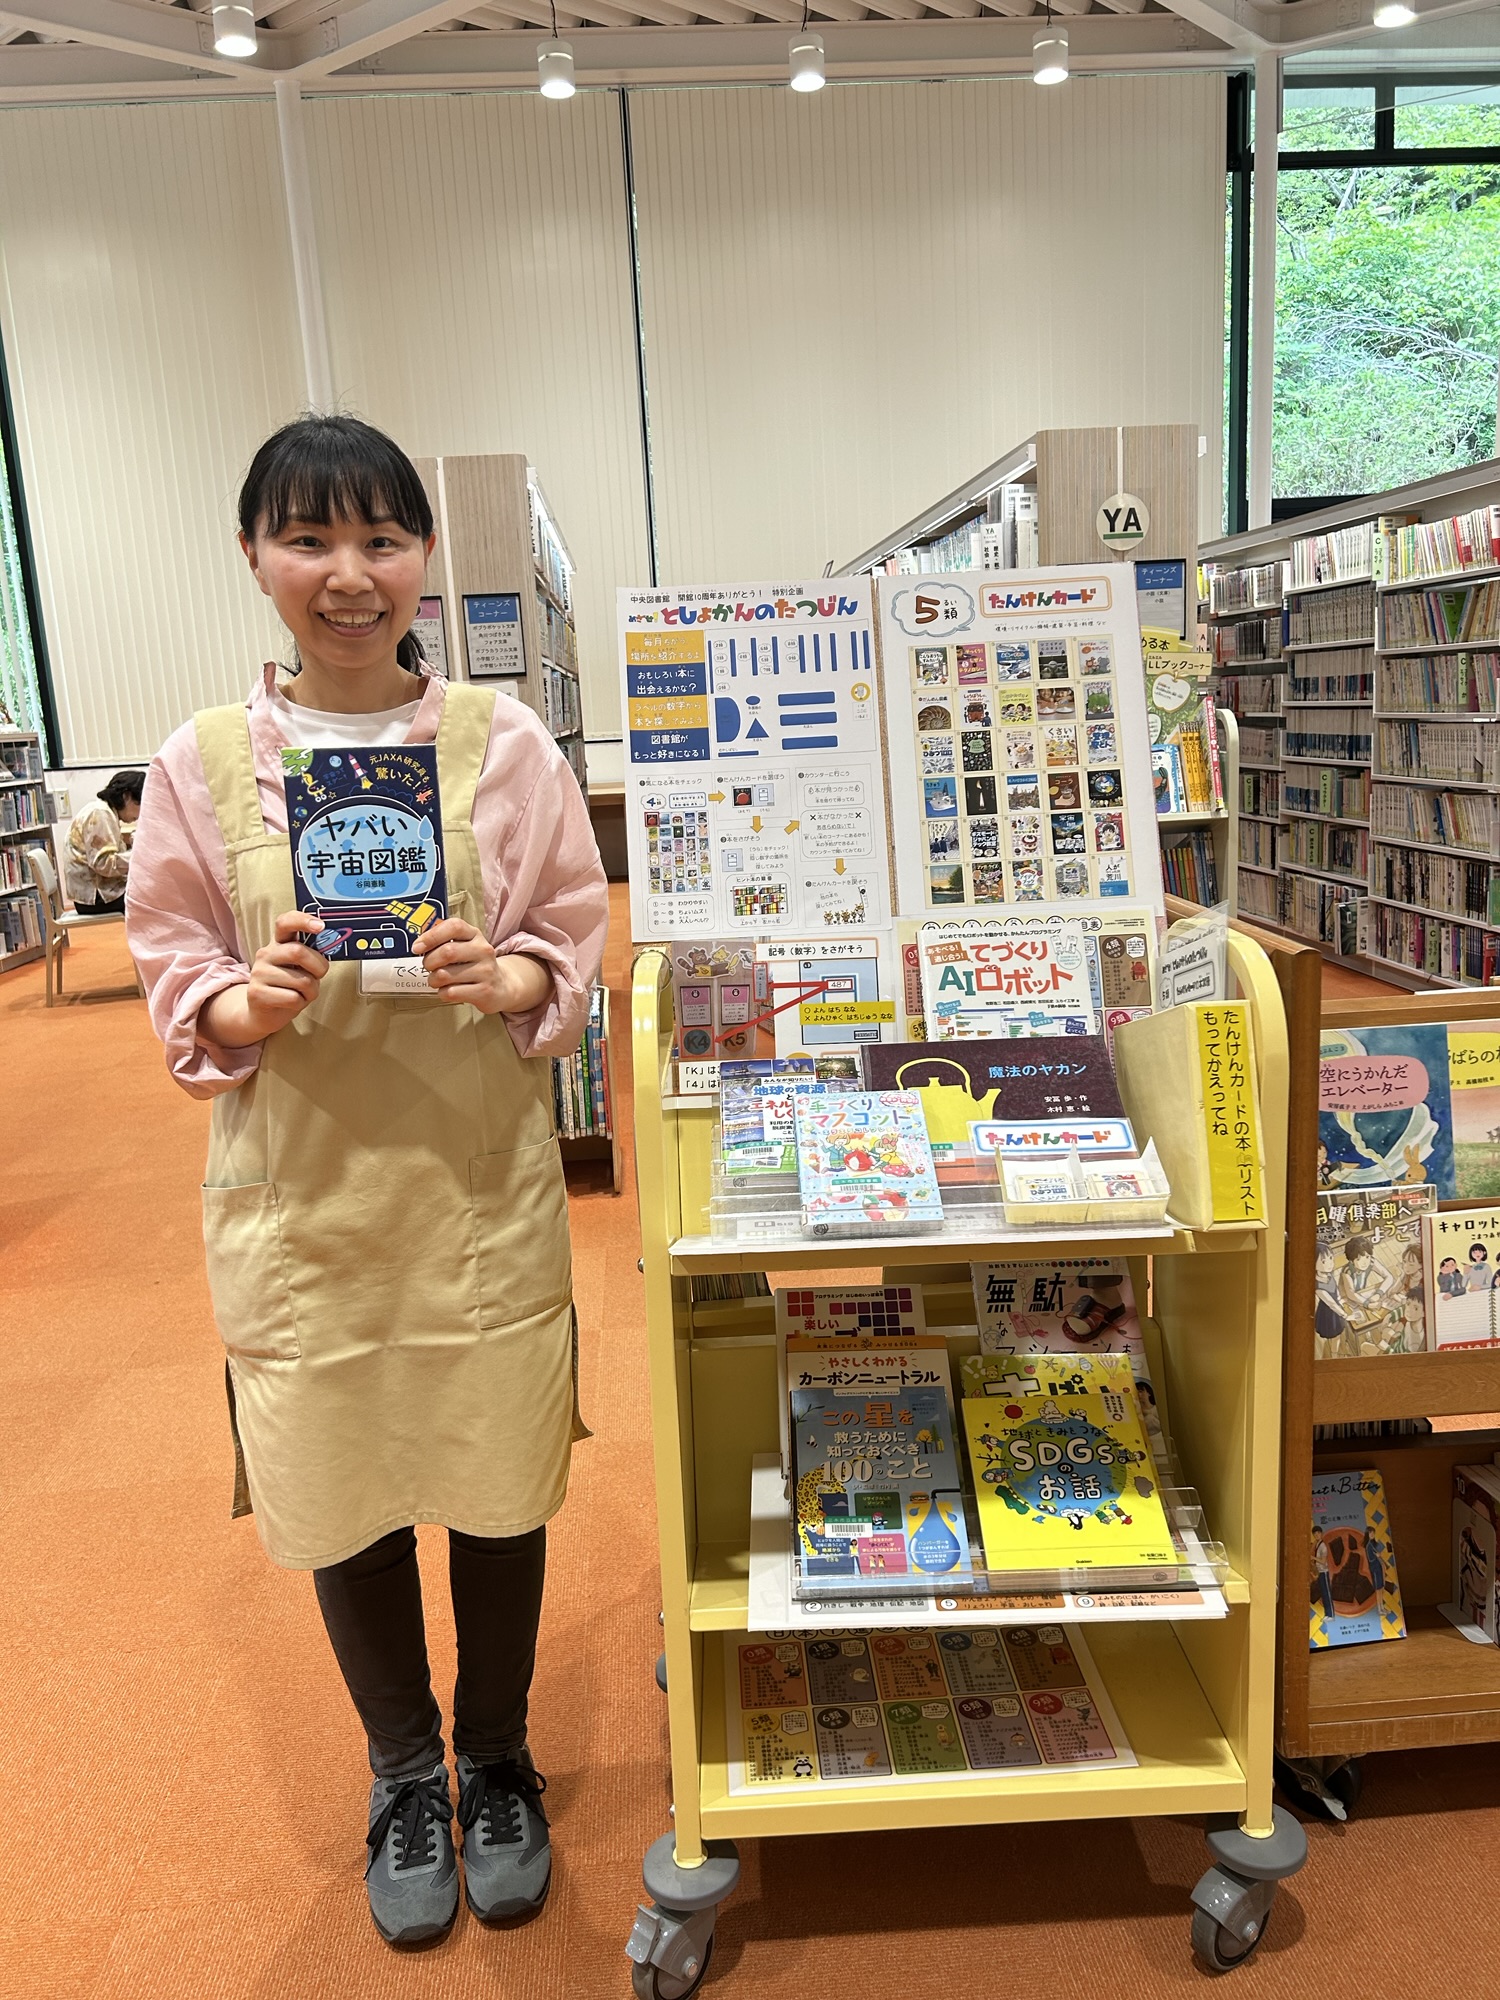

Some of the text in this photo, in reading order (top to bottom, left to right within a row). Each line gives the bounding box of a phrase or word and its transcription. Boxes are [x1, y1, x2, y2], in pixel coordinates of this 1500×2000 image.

[1103, 508, 1141, 532] YA
[1141, 566, 1177, 575] ティーンズ
[630, 595, 670, 604] 中央図書館
[772, 587, 803, 597] 特別企画
[989, 588, 1096, 609] たんけんカード
[661, 595, 858, 625] としょかんのたつじん
[631, 651, 701, 662] 場所を紹介するよ
[638, 669, 695, 679] おもしろい本に
[637, 683, 697, 694] 出会えるかな?
[634, 701, 701, 712] ラベルの数字から
[634, 717, 702, 727] 本を探してみよう
[651, 734, 689, 745] 図書館が
[634, 749, 705, 761] もっと好きになる!
[376, 767, 421, 790] 驚いた!
[320, 814, 408, 841] ヤバい
[307, 846, 427, 878] 宇宙図鑑
[970, 940, 1048, 962] てづくり
[1106, 939, 1120, 951] 4類
[939, 963, 1074, 996] AIロボット
[1110, 1014, 1126, 1024] 9類
[686, 1032, 709, 1048] K4
[988, 1063, 1087, 1079] 魔法のヤカン
[1204, 1010, 1229, 1137] もってかえってね
[1320, 1064, 1408, 1083] 空にうかんだ
[753, 1084, 826, 1095] 地球の資源
[1322, 1084, 1408, 1098] エレベーター
[750, 1102, 792, 1111] エネル
[810, 1098, 872, 1113] 手づくり
[1224, 1009, 1255, 1217] たんけんカードの本 リスト
[809, 1110, 911, 1128] マスコット
[986, 1129, 1111, 1146] たんけんカード
[1316, 1203, 1412, 1225] 月曜倶楽部へ
[1439, 1217, 1499, 1233] キャロット
[986, 1272, 1066, 1313] 無駄
[804, 1319, 840, 1331] 楽しい
[996, 1320, 1012, 1338] な
[829, 1356, 908, 1368] やさしくわかる
[799, 1371, 940, 1386] カーボンニュートラル
[822, 1402, 915, 1428] この星を
[834, 1431, 907, 1444] 救うために
[1000, 1424, 1114, 1440] 地球ときみをつなぐ
[827, 1443, 920, 1458] 知っておくべき
[1009, 1437, 1114, 1471] SDGs
[820, 1456, 932, 1483] 100のこと
[1060, 1464, 1071, 1472] の
[1039, 1473, 1101, 1500] お話
[1337, 1477, 1380, 1494] Bitter
[892, 1706, 911, 1717] 7類
[962, 1700, 983, 1713] 8類
[822, 1710, 842, 1722] 6類
